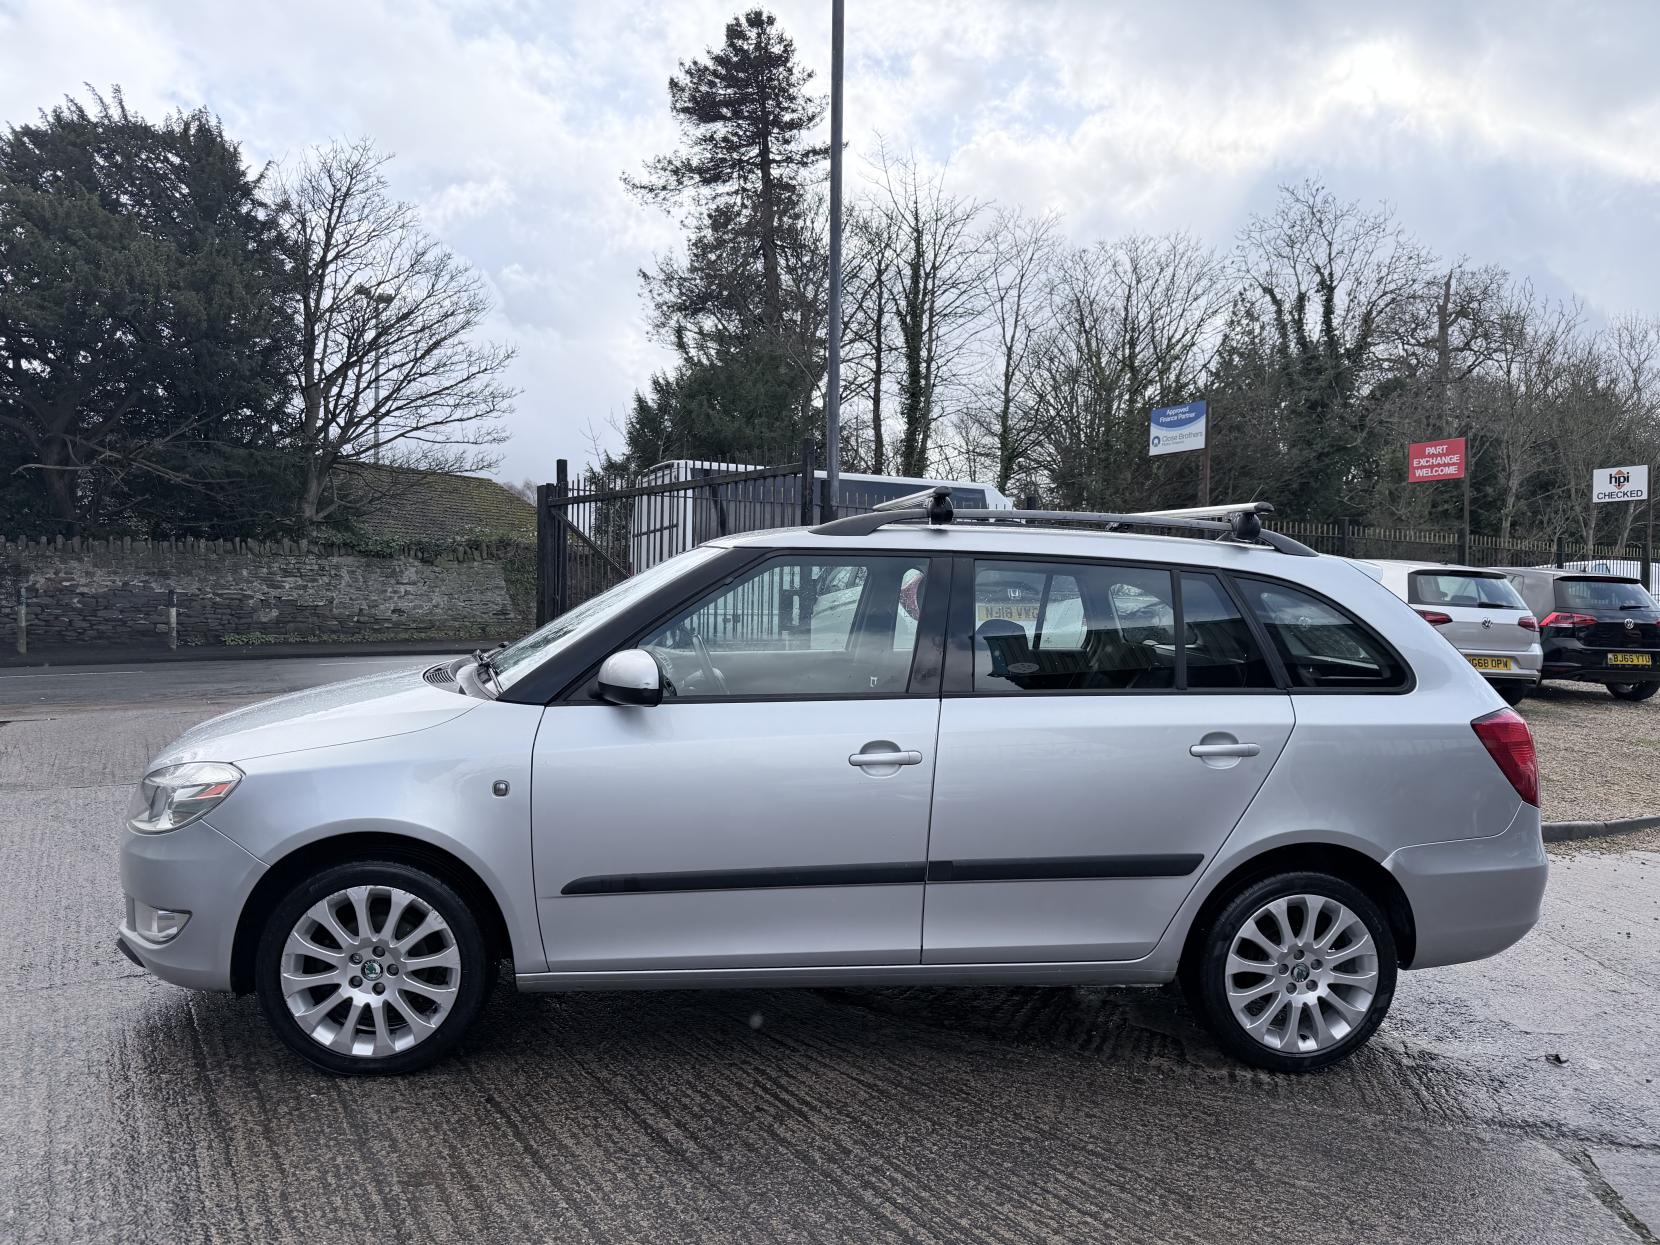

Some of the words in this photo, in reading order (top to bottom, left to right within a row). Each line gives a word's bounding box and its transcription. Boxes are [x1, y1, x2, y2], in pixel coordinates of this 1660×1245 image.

[1425, 445, 1448, 455] PART
[1413, 454, 1460, 467] EXCHANGE
[1415, 465, 1458, 477] WELCOME
[1609, 471, 1630, 487] hpi
[1596, 489, 1643, 500] CHECKED
